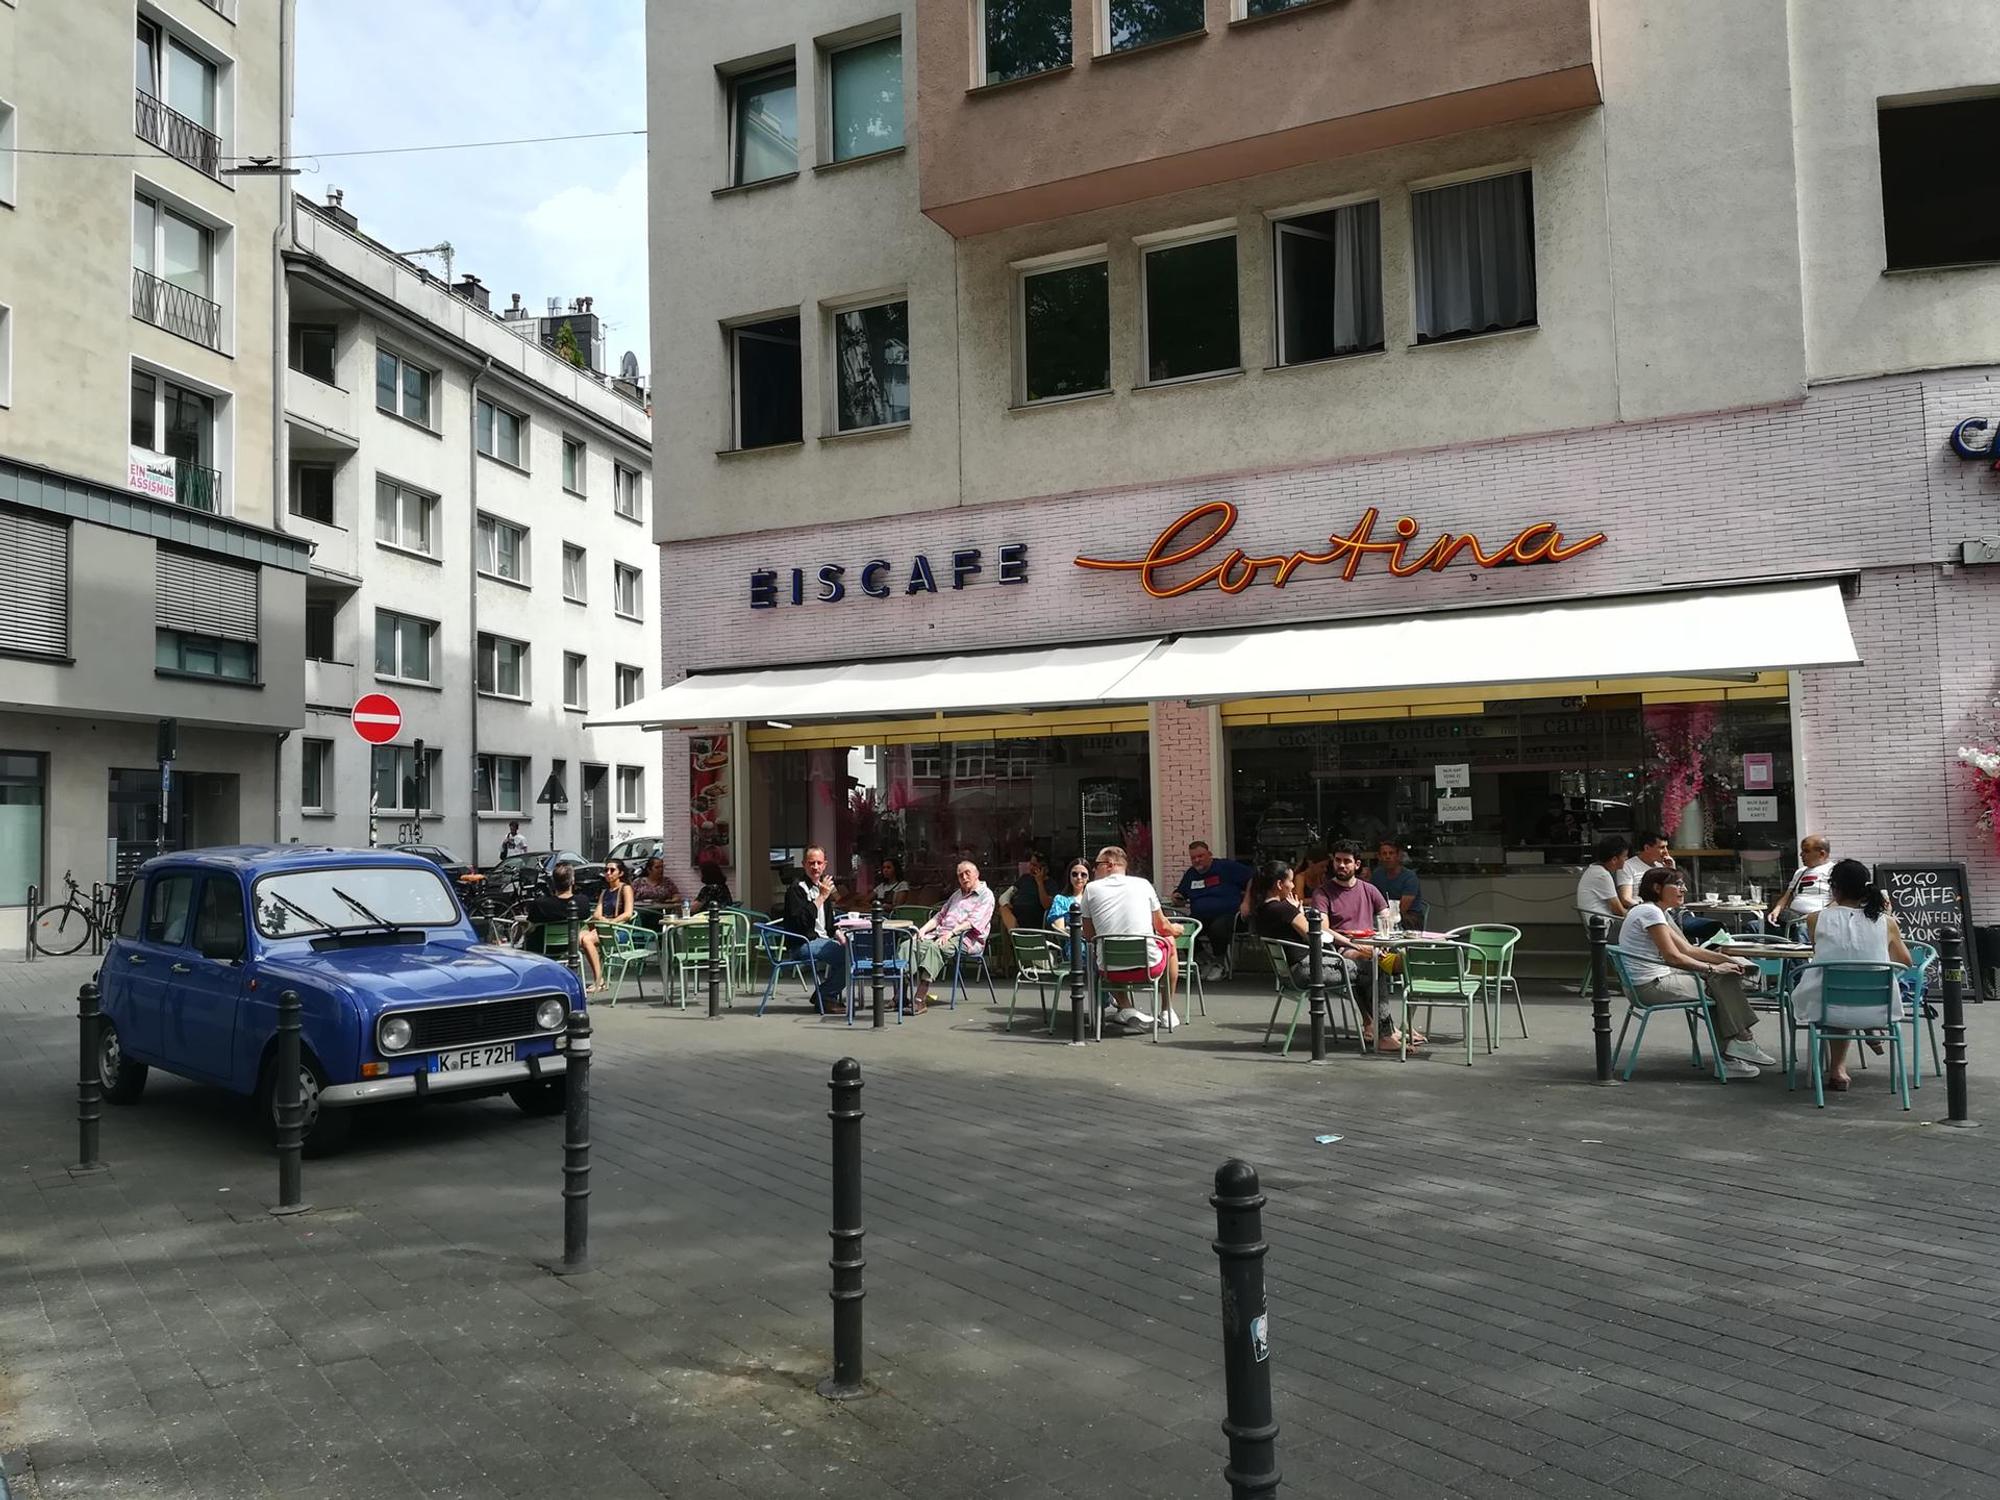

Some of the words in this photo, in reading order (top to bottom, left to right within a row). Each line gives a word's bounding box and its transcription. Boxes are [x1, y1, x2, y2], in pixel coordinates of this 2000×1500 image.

[750, 543, 1029, 609] EISCAFE
[1074, 501, 1607, 598] Cortina
[439, 1054, 451, 1073] K
[460, 1050, 482, 1070] FE
[484, 1044, 515, 1067] 72H
